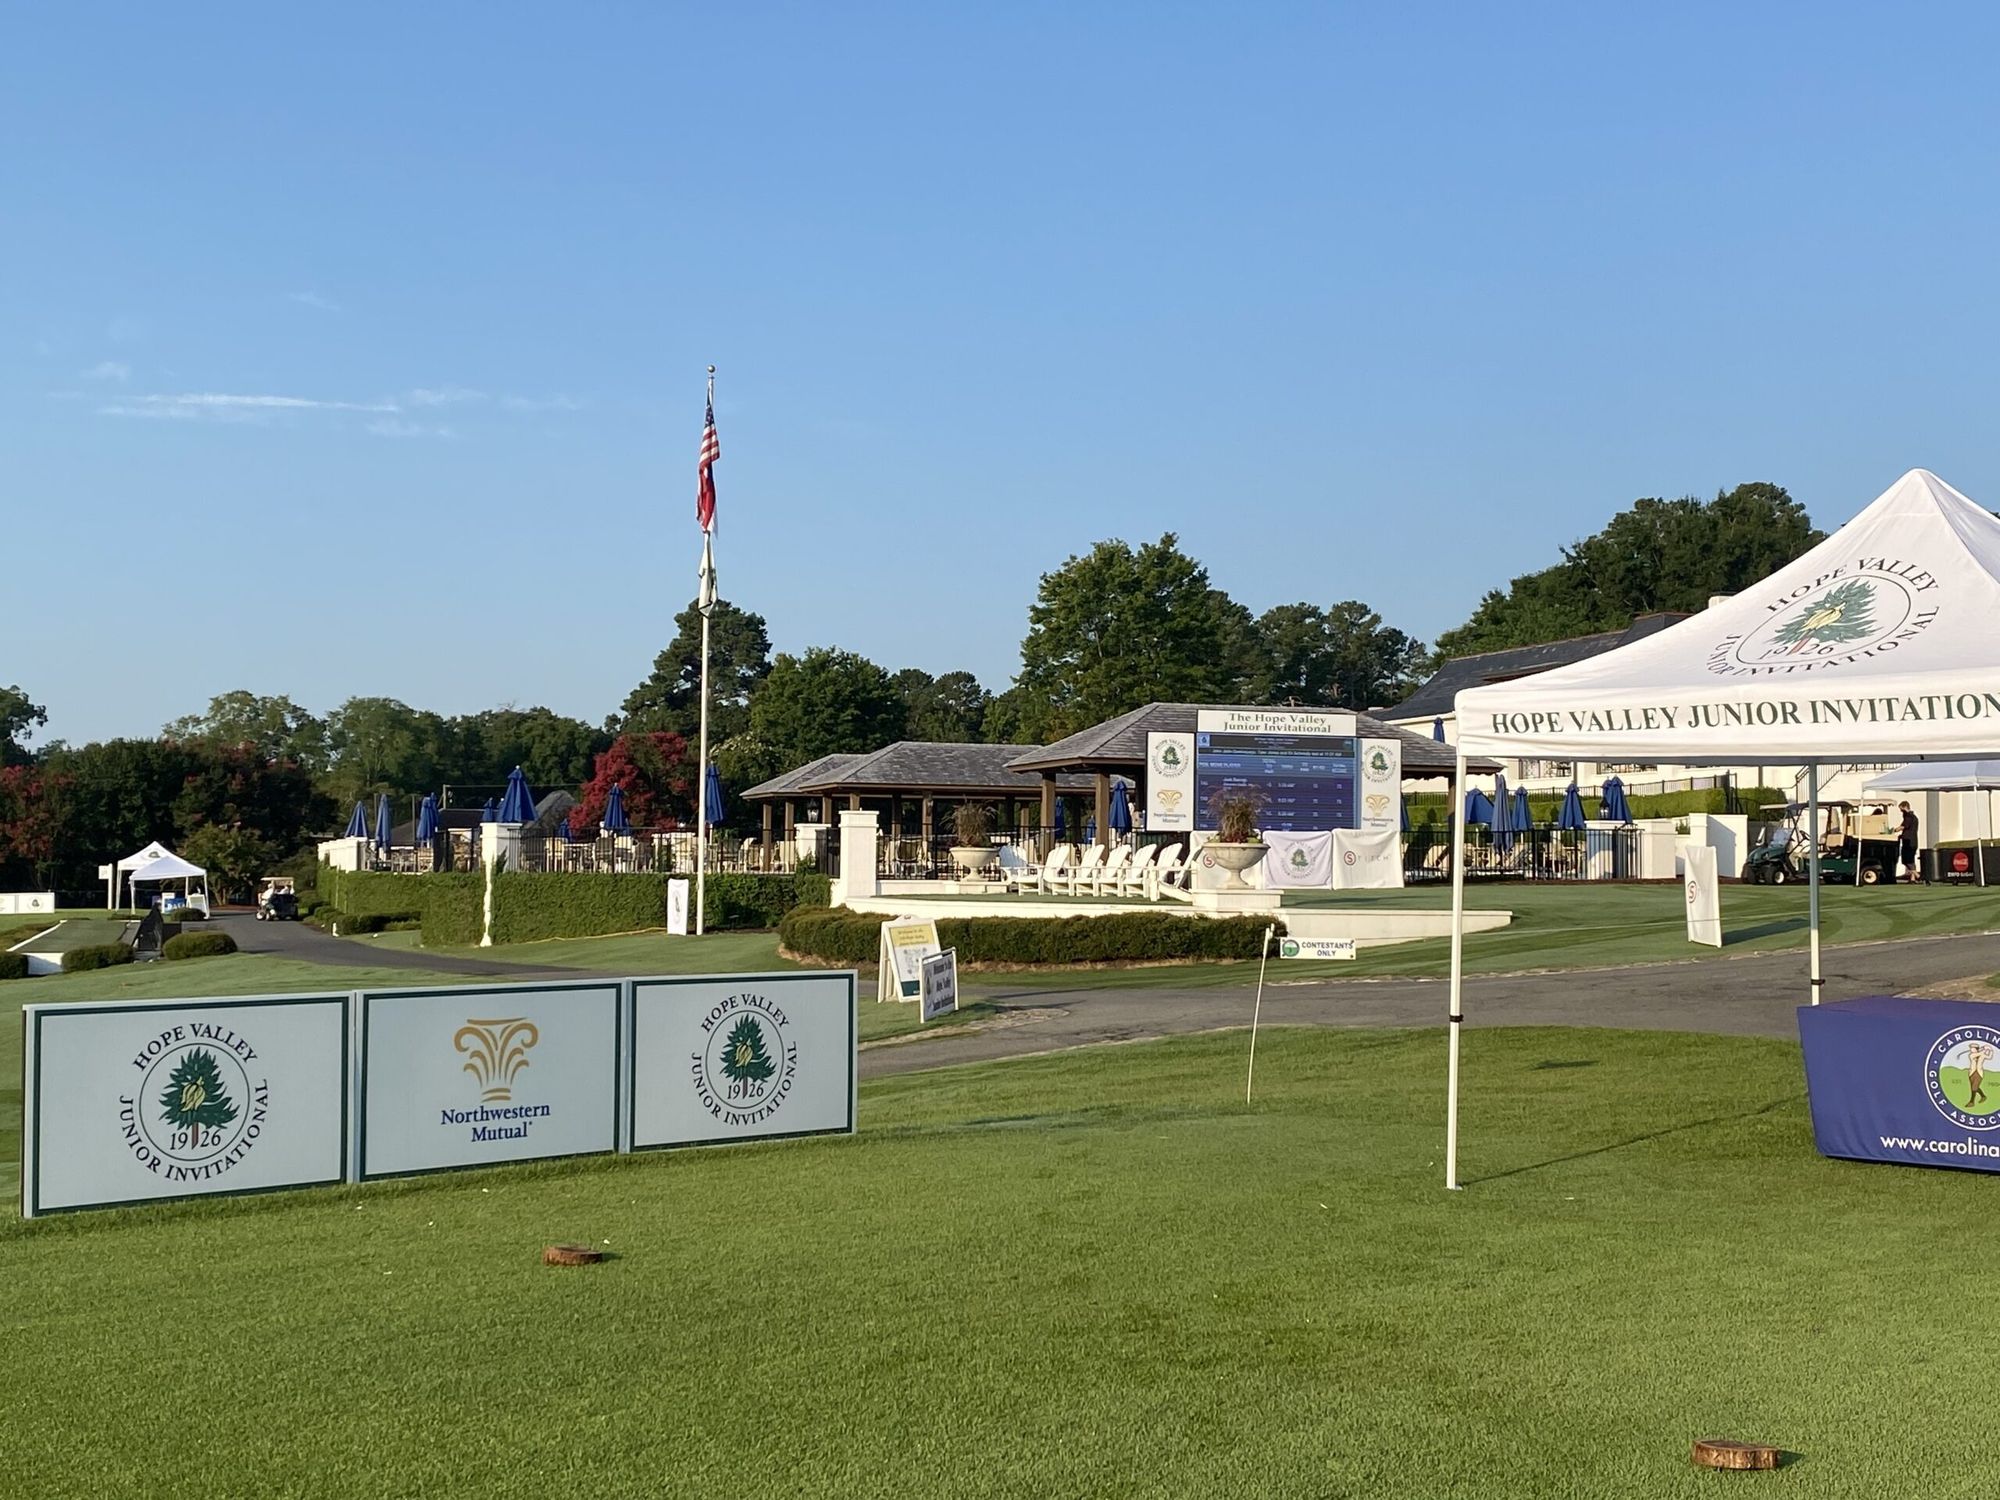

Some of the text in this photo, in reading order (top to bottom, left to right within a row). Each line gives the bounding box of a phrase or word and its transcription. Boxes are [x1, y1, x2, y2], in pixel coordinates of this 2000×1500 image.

[1766, 557, 1940, 613] HOPE VALLEY
[1707, 605, 1940, 676] JUNIOR INVITATIONAL
[1223, 722, 1331, 733] Junior Invitational
[1229, 713, 1327, 726] The Hope Valley
[1491, 711, 1563, 734] HOPE
[1569, 705, 1679, 732] VALLEY
[1688, 700, 1802, 728] JUNIOR
[1301, 941, 1353, 949] CONTESTANTS
[701, 994, 789, 1033] HOPE VALLEY
[132, 1023, 259, 1073] HOPE VALLEY
[690, 1041, 797, 1126] JUNIOR INVITATIONAL
[1929, 1071, 1947, 1107] GOLF
[119, 1078, 269, 1182] JUNIOR INVITATIONAL
[441, 1104, 551, 1125] Northwestern
[471, 1122, 528, 1142] Mutual
[1880, 1136, 2000, 1158] www.carolina
